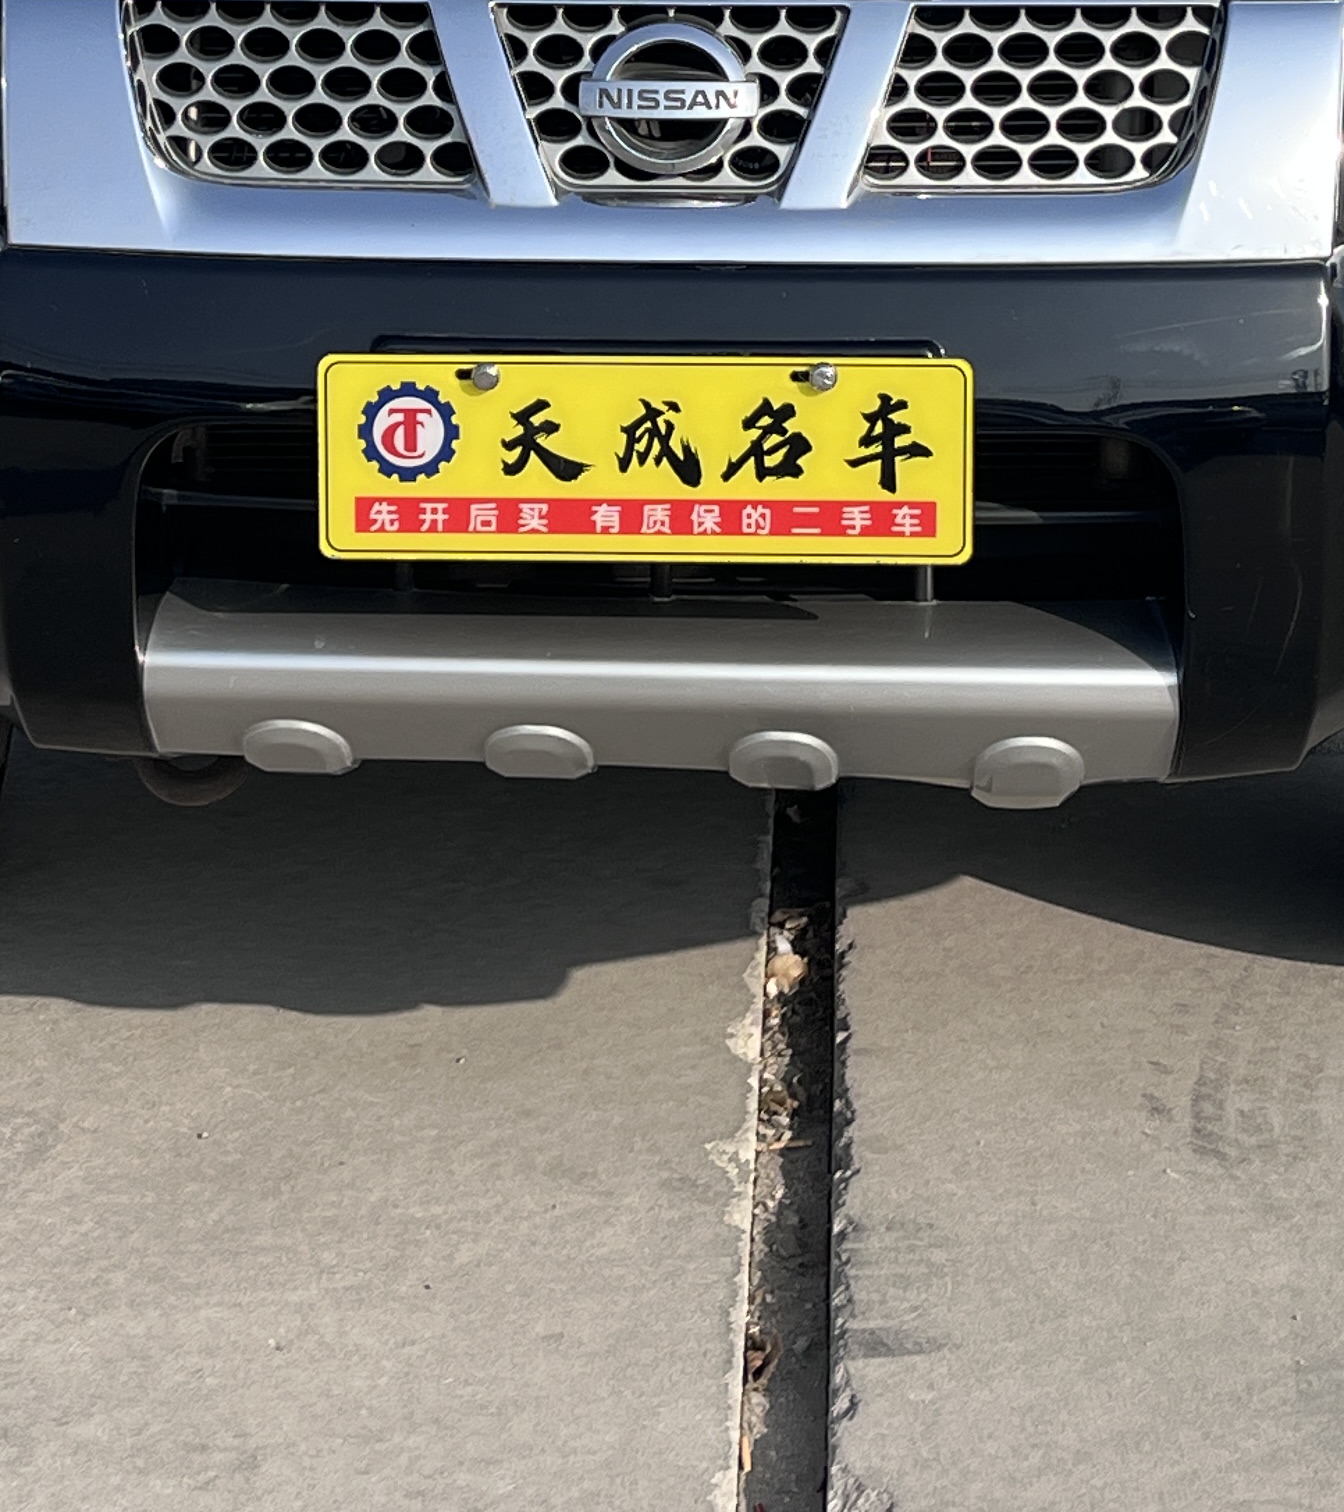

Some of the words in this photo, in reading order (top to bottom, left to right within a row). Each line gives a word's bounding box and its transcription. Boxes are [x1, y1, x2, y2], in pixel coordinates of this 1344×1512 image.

[595, 87, 739, 111] NISSAN
[500, 391, 934, 494] 天成名车
[368, 500, 550, 533] 先开后买
[590, 501, 924, 537] 有质保的二手车
